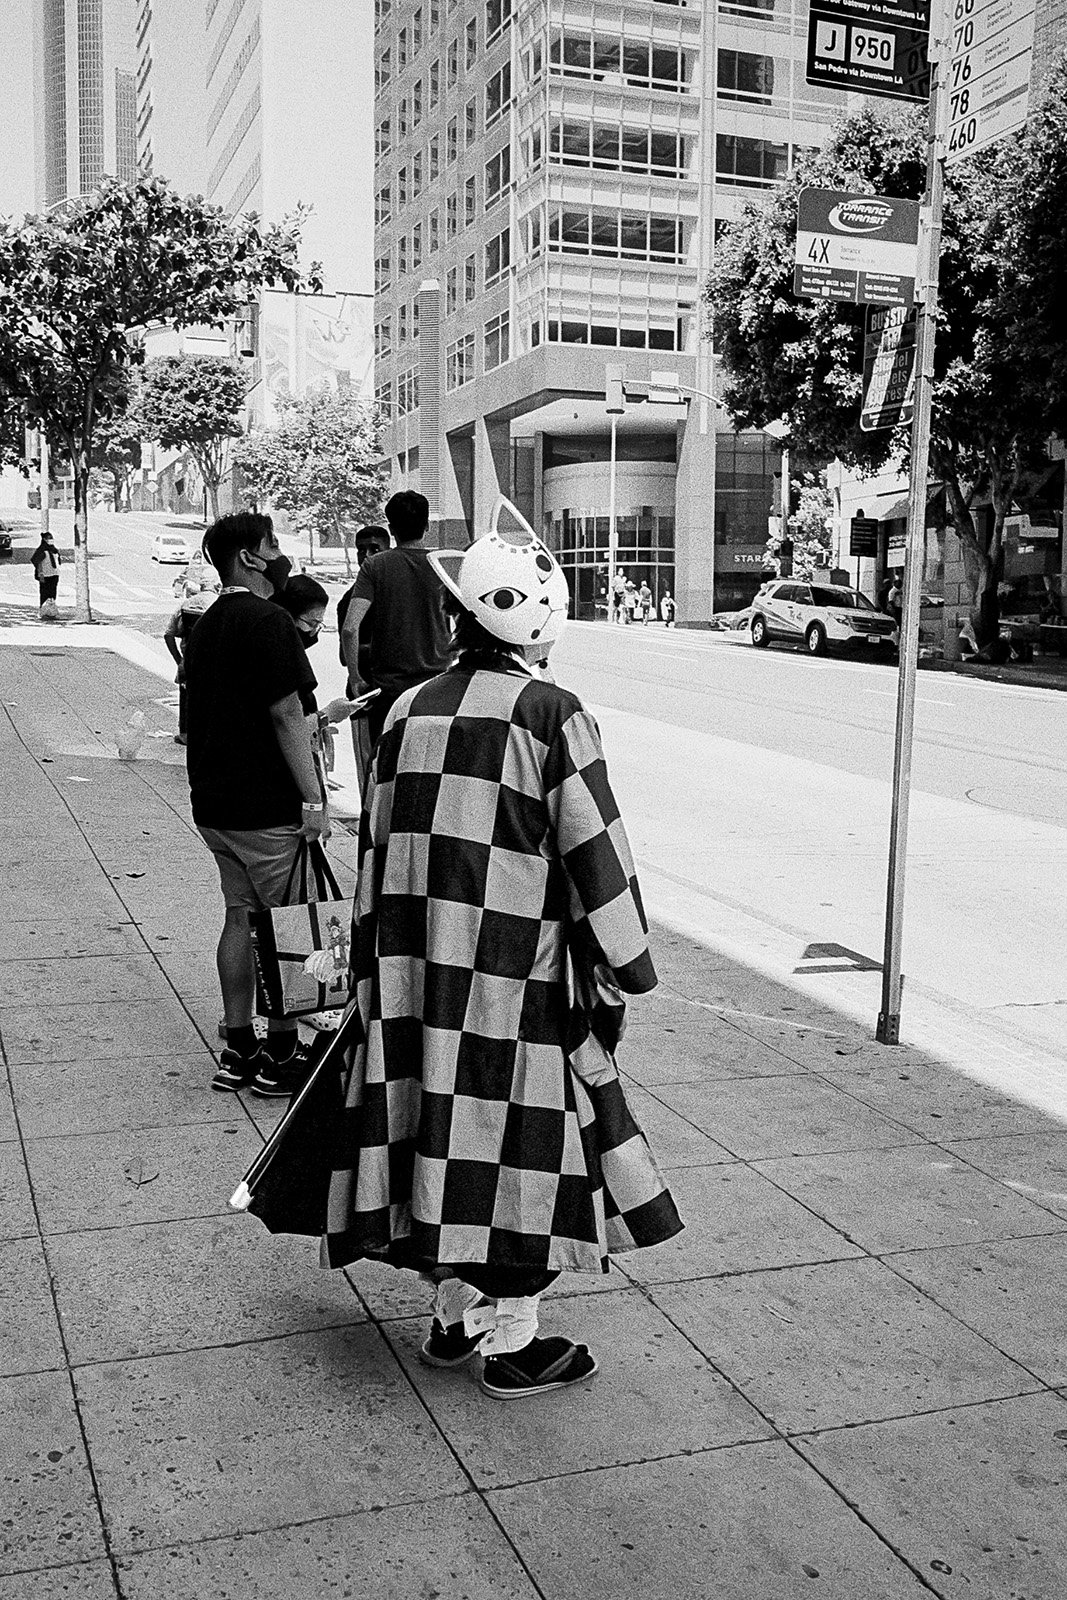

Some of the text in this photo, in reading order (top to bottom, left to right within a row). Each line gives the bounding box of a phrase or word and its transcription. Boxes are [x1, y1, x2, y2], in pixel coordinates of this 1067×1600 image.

[871, 5, 882, 13] via
[882, 5, 915, 19] Downtown
[916, 12, 926, 22] LA
[824, 29, 892, 62] J 950
[954, 20, 974, 52] 70
[814, 61, 904, 85] San Pedro via Downtown LA
[952, 55, 972, 87] 76
[950, 89, 970, 120] 78
[949, 118, 976, 151] 460
[838, 201, 894, 217] TORRANCE
[842, 212, 888, 225] TRANSIT
[808, 237, 830, 264] 4X
[871, 310, 890, 331] BUS
[734, 554, 762, 563] STAR
